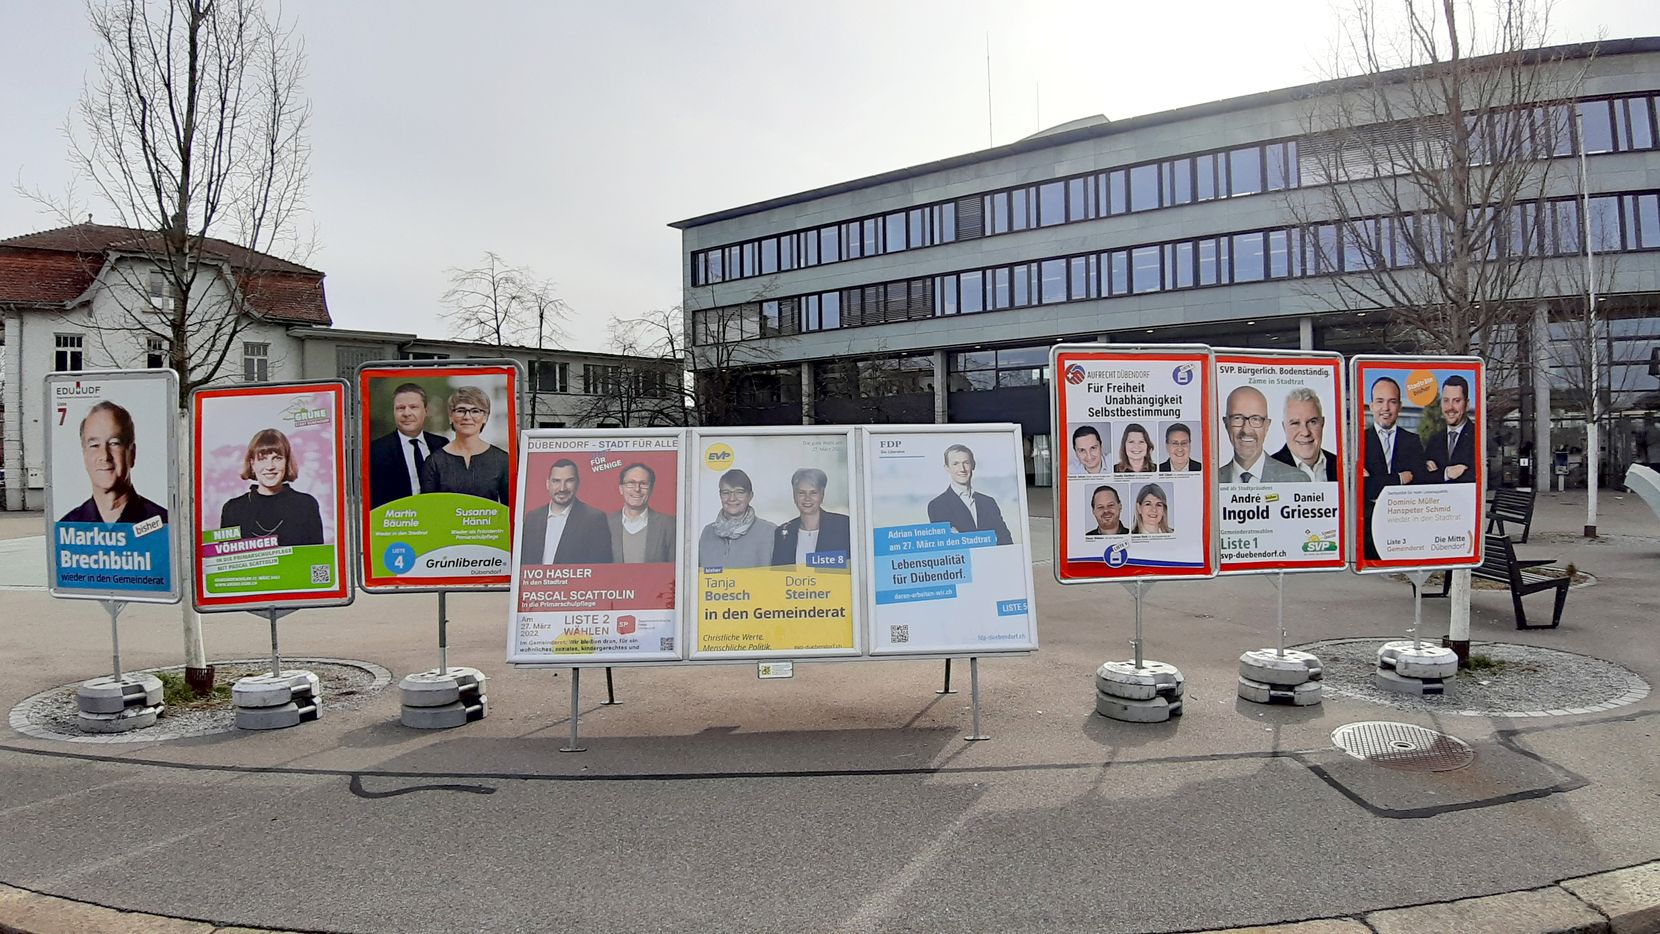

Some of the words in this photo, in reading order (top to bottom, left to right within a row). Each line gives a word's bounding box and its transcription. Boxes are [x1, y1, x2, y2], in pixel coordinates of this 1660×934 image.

[1087, 370, 1116, 379] AUFRECHT
[1117, 369, 1150, 379] DÜBENDORF
[1220, 366, 1236, 374] SVP.
[1238, 366, 1278, 376] Bürgerlich.
[1280, 367, 1330, 378] Bodenständig.
[57, 386, 75, 395] EDU
[82, 386, 100, 394] UDF
[1088, 382, 1104, 393] Für
[1107, 382, 1146, 393] Freiheit
[1105, 394, 1182, 407] Unabhängigkeit
[57, 408, 67, 426] 7
[1088, 406, 1181, 419] Selbstbestimmung
[528, 440, 590, 450] DÜBENDORF
[598, 440, 630, 448] STADT
[632, 439, 652, 448] FÜR
[654, 440, 678, 448] ALLE
[590, 456, 606, 466] FÜR
[708, 451, 731, 460] EVP
[592, 459, 622, 472] WENIGE
[1231, 493, 1262, 504] André
[1294, 492, 1324, 502] Daniel
[1418, 497, 1440, 505] Müller
[385, 510, 417, 518] Martin
[456, 508, 498, 517] Susanne
[1222, 505, 1270, 524] Ingold
[1280, 505, 1338, 519] Griesser
[1388, 507, 1424, 515] Hanspeter
[135, 519, 160, 535] bisher
[462, 517, 491, 526] Hänni
[60, 527, 126, 546] Markus
[214, 528, 240, 540] NINA
[888, 528, 912, 538] Adrian
[914, 526, 946, 537] Ineichen
[215, 536, 278, 554] VÖHRINGER
[916, 540, 936, 549] März
[937, 538, 944, 547] in
[946, 537, 960, 546] den
[961, 535, 992, 544] Stadtrat
[1220, 537, 1251, 550] Liste
[1252, 537, 1258, 549] 1
[1307, 542, 1330, 551] SVP
[1430, 544, 1466, 552] Dübendorf
[61, 550, 151, 570] Brechbühl
[812, 556, 835, 564] Liste
[838, 556, 844, 564] 8
[1220, 550, 1287, 560] svp-duebendorf.ch
[394, 556, 404, 568] 4
[426, 556, 502, 568] Grünliberale
[891, 554, 966, 571] Lebensqualität
[524, 569, 544, 579] IVO
[546, 568, 592, 578] HASLER
[892, 573, 908, 585] für
[910, 568, 966, 584] Dübendorf.
[62, 574, 86, 582] wieder
[97, 574, 112, 582] den
[113, 575, 165, 585] Gemeinderat
[705, 578, 736, 590] Tanja
[786, 576, 817, 586] Doris
[522, 591, 568, 601] PASCAL
[570, 590, 635, 600] SCATTOLIN
[705, 590, 750, 601] Boesch
[786, 589, 831, 600] Steiner
[540, 600, 596, 608] Primarschulpflege
[1002, 602, 1022, 612] LISTE
[704, 608, 718, 620] in
[722, 608, 748, 620] den
[754, 606, 846, 619] Gemeinderat
[564, 614, 600, 625] LISTE
[602, 614, 610, 624] 2
[564, 625, 610, 636] WÄHLEN
[702, 634, 740, 642] Christliche
[702, 644, 747, 652] Menschliche
